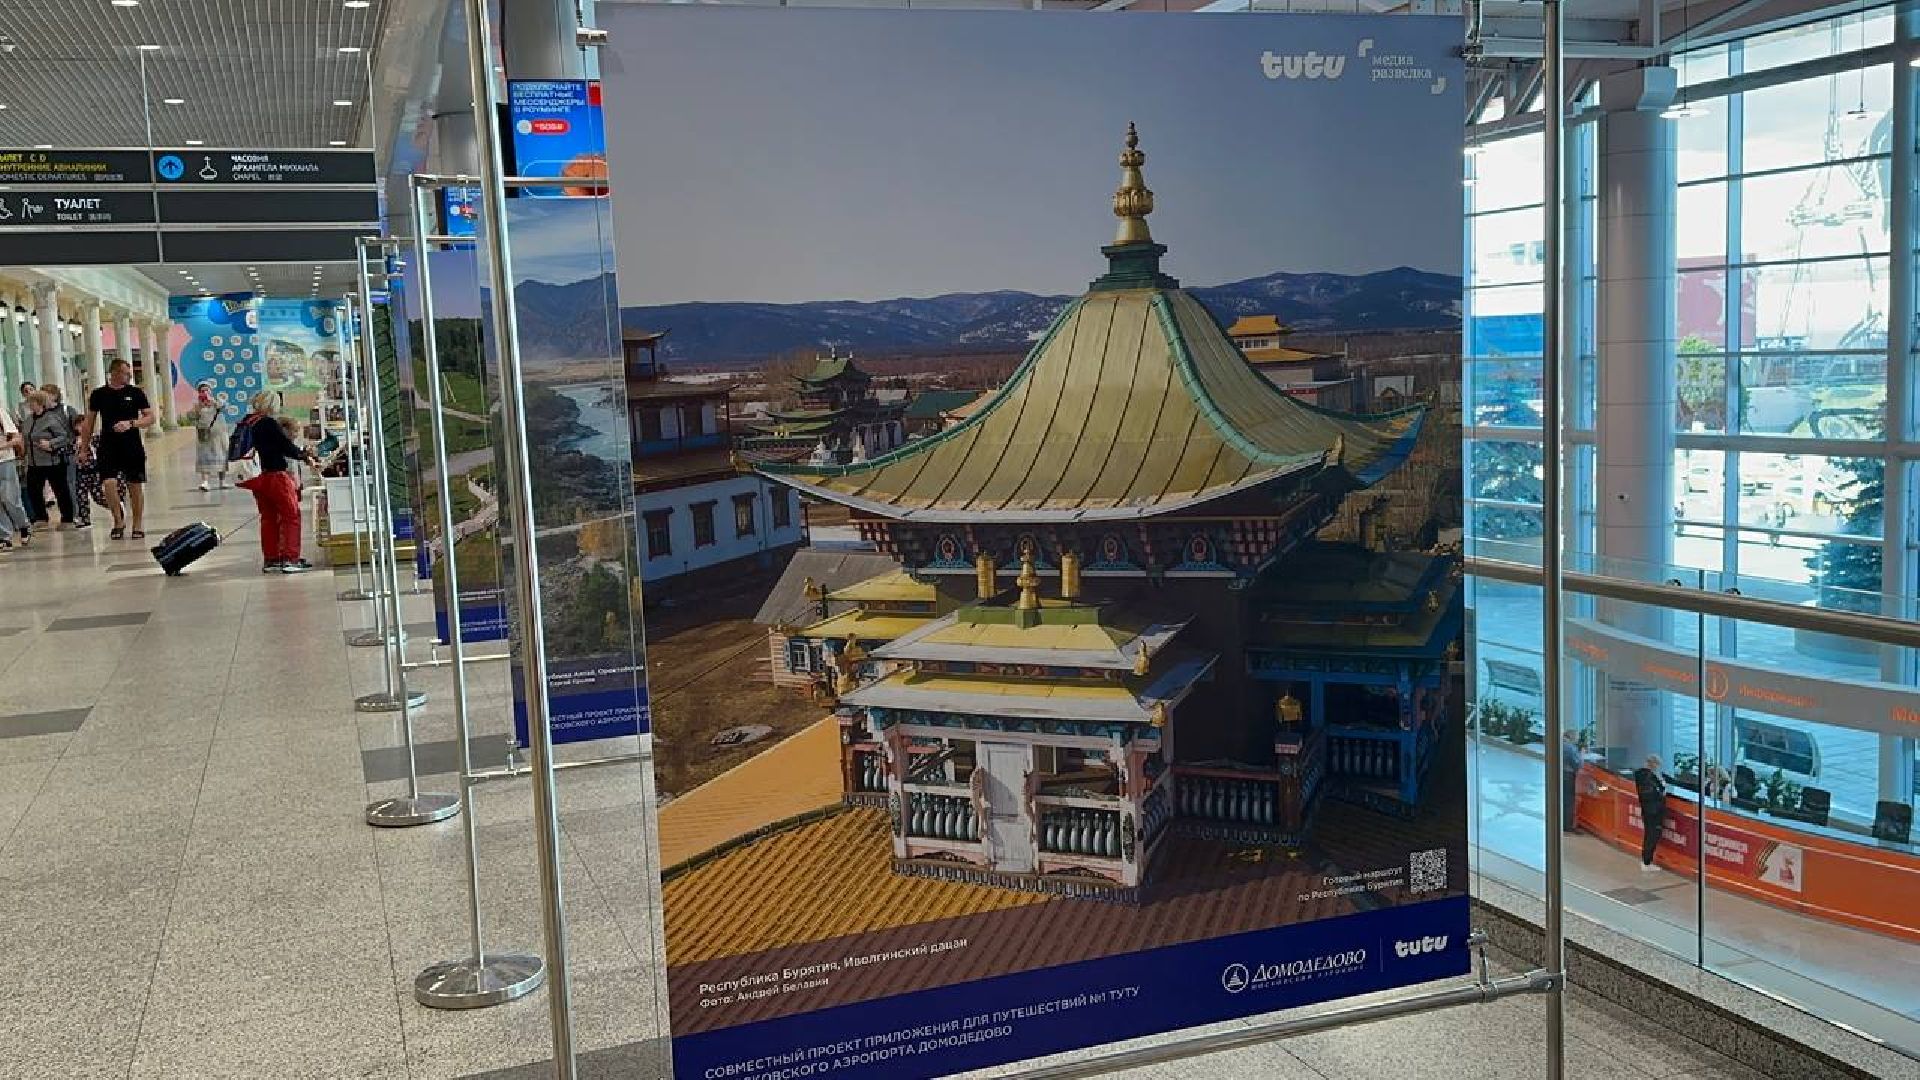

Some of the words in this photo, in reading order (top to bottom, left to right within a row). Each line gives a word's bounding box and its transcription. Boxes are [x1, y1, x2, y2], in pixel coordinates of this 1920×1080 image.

[1260, 51, 1345, 80] tutu
[1371, 54, 1414, 66] медиа
[1371, 68, 1432, 82] разведка
[0, 163, 50, 172] НУТРЕННИЕ
[0, 173, 36, 181] OMESTIC
[54, 198, 101, 209] ТУАЛЕТ
[57, 213, 83, 221] TOILET
[1322, 873, 1362, 886] Готовый
[1363, 866, 1403, 880] маршрут
[1298, 893, 1310, 901] по
[1395, 935, 1448, 957] tutu
[699, 971, 779, 995] Республика
[783, 962, 842, 985] Бурятия,
[843, 943, 928, 968] Иволгинский
[930, 937, 968, 954] дацан
[1251, 949, 1366, 983] ДОМОДЕДОВО
[700, 993, 734, 1009] Фото:
[737, 983, 779, 1001] Андрей
[782, 976, 829, 993] Белавин
[705, 1048, 804, 1079] СОВМЕСТНЫЙ
[807, 1038, 861, 1058] ПРОЕКТ
[864, 1019, 959, 1048] ПРИЛОЖЕНИЯ
[963, 1013, 989, 1031] ДЛЯ
[993, 994, 1087, 1024] ПУТЕШЕСТВИЙ
[1109, 986, 1140, 1000] ТУТУ
[833, 1046, 916, 1070] АЭРОПОРТА
[919, 1025, 1012, 1054] ДОМОДЕДОВО
